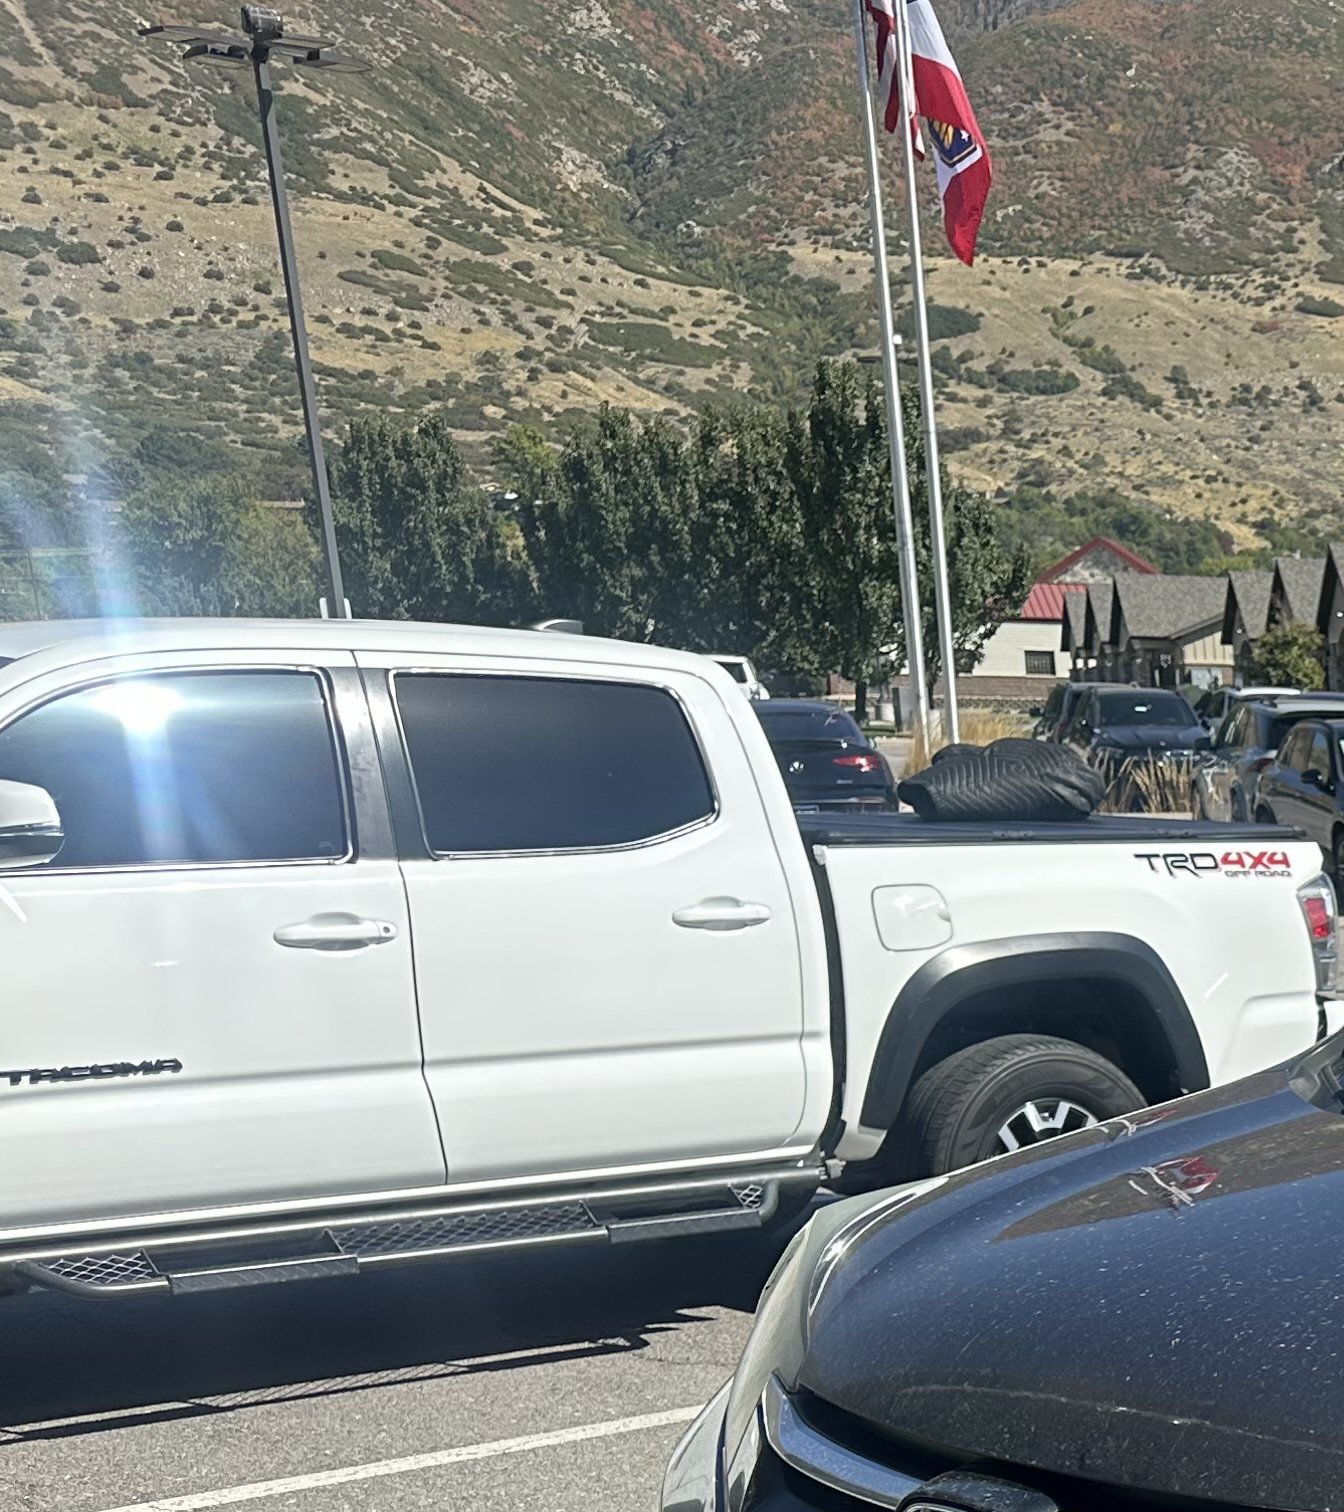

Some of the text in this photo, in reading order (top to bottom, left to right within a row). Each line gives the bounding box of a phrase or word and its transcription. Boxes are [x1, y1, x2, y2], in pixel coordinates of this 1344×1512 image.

[1133, 853, 1220, 879] TRD
[1224, 870, 1292, 878] OFF ROAD
[0, 1058, 183, 1086] TACOMA
